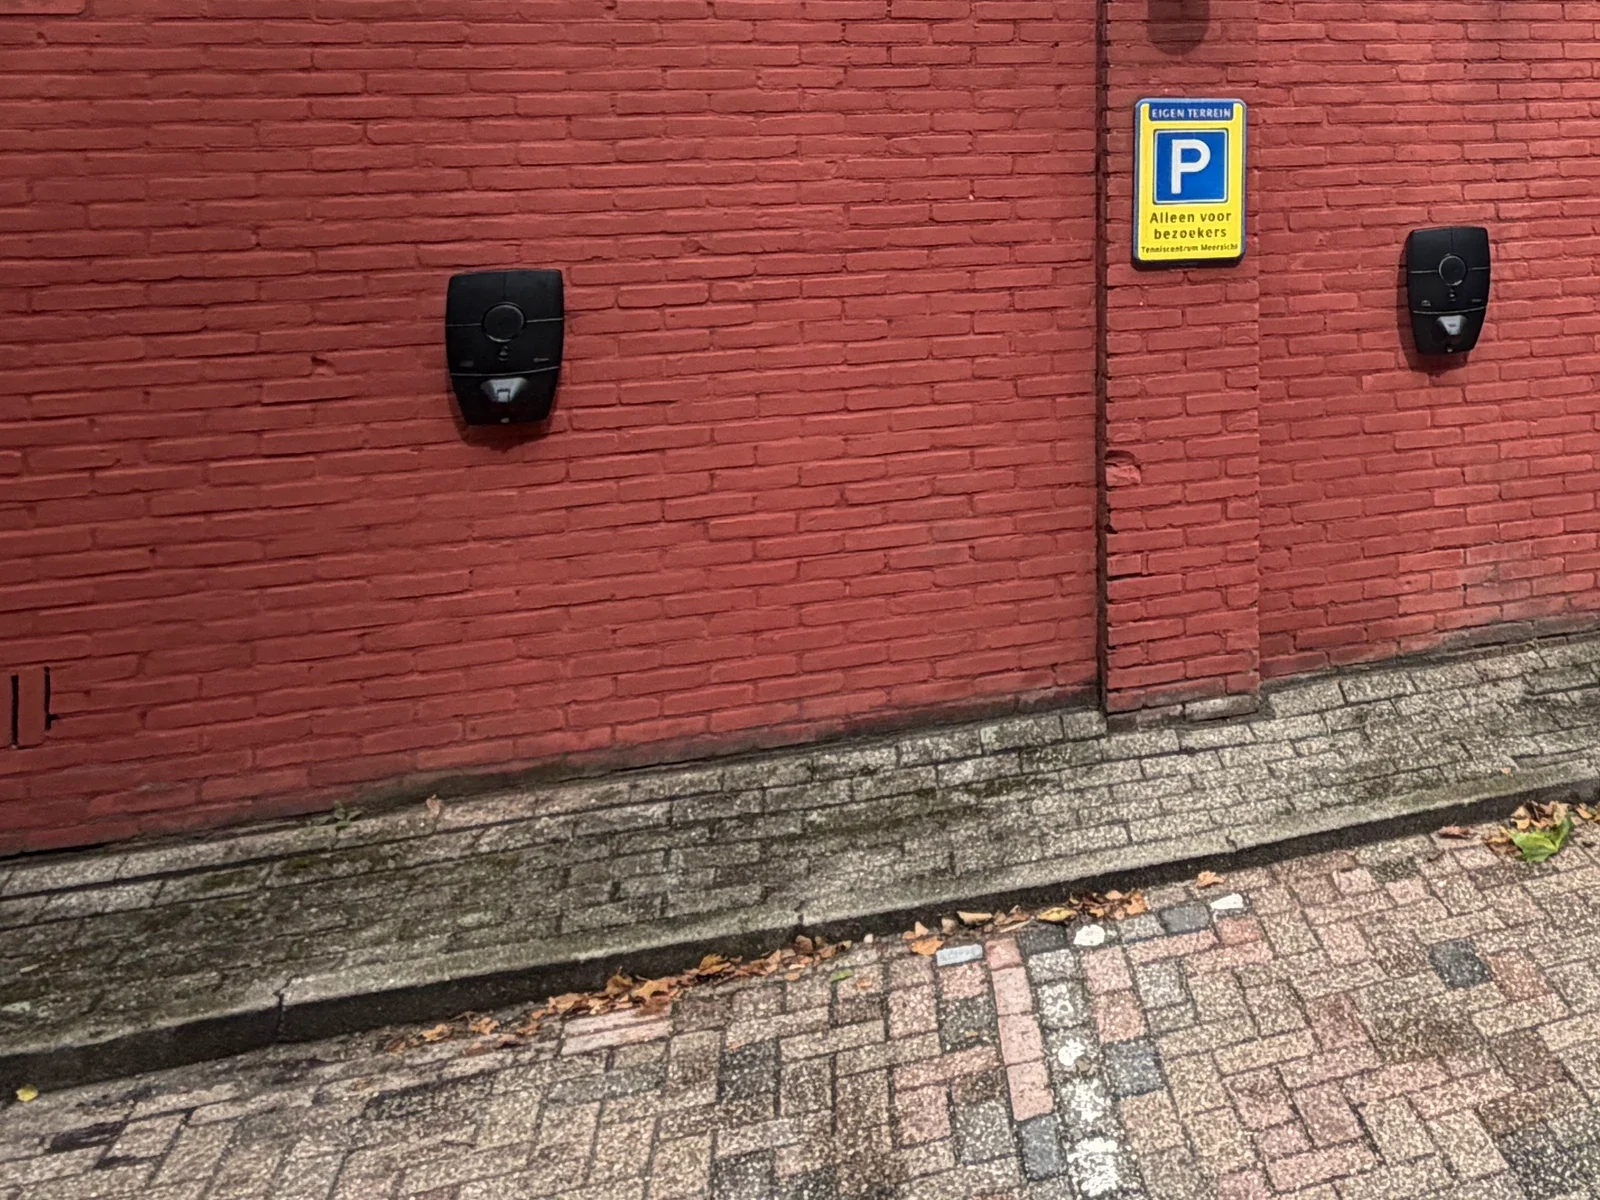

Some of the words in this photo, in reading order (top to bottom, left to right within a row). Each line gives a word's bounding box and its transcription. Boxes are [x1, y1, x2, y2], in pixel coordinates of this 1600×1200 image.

[1151, 108, 1185, 118] EIGEN
[1187, 108, 1232, 118] TERREIN
[1170, 138, 1212, 195] P
[1149, 211, 1195, 224] Alleen
[1199, 211, 1232, 223] voor
[1153, 227, 1228, 240] bezoekers
